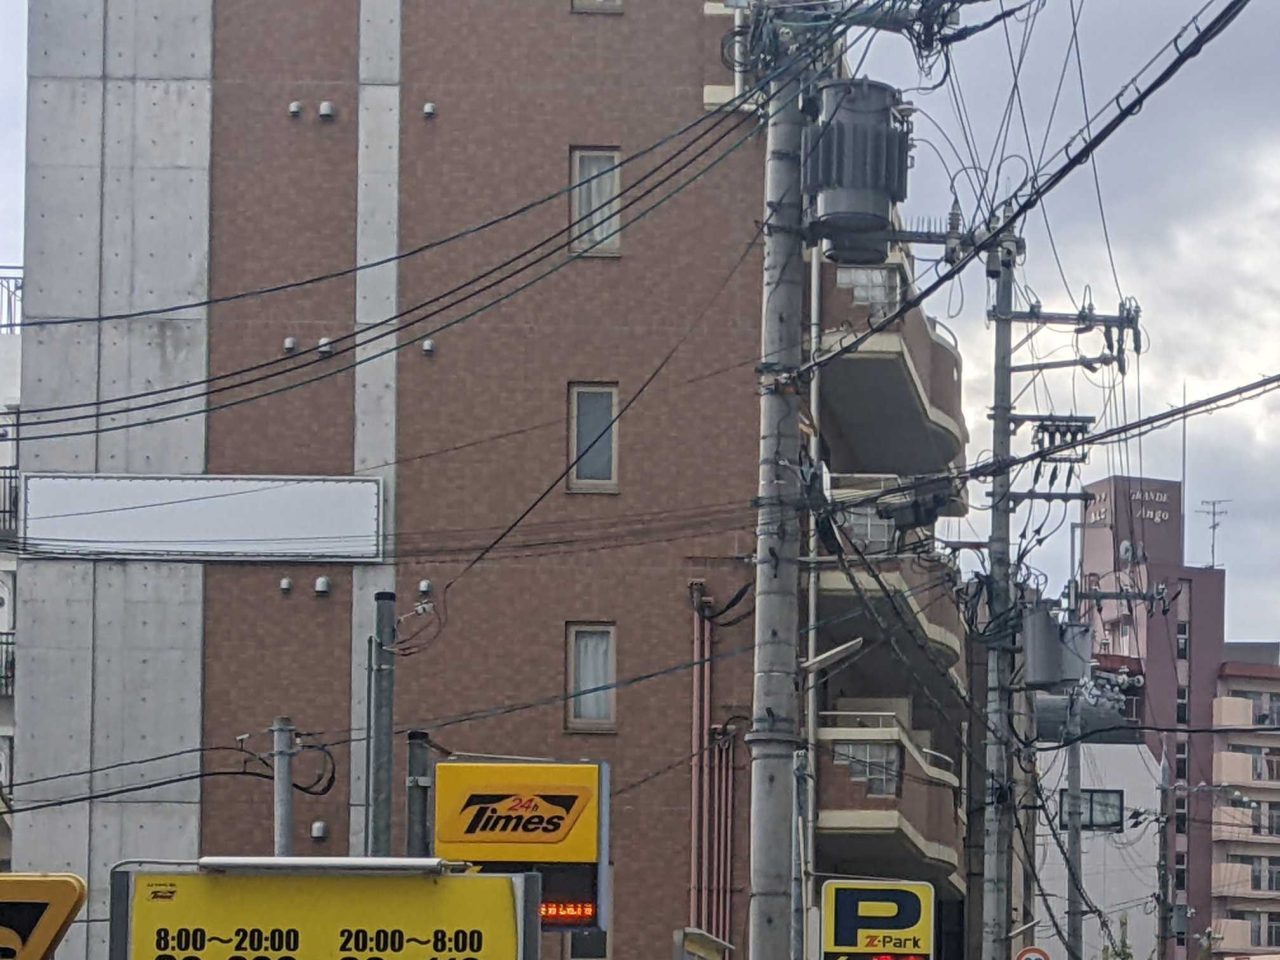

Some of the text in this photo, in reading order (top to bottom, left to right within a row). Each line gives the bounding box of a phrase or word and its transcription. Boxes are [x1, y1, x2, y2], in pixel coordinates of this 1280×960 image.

[1136, 505, 1169, 524] Ango
[460, 796, 568, 834] Times
[833, 887, 922, 947] P
[864, 935, 921, 949] Z-Park
